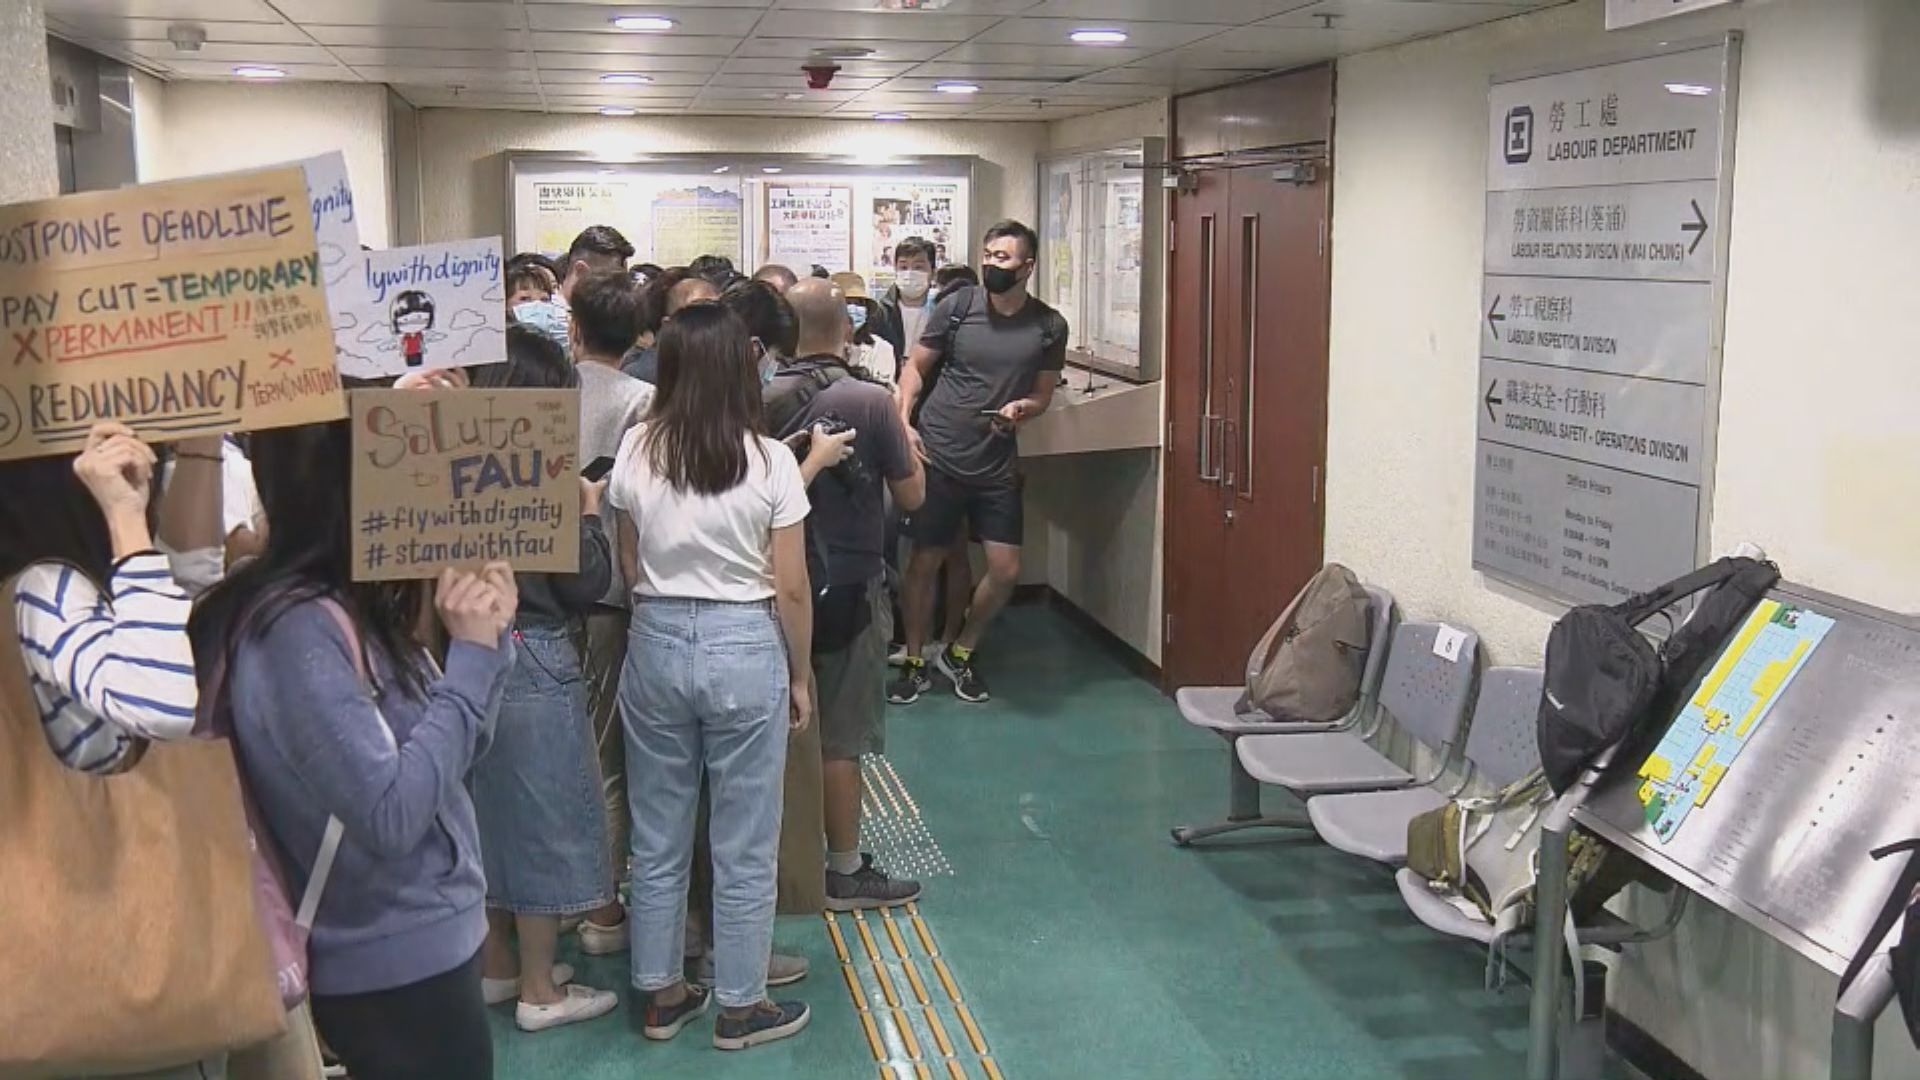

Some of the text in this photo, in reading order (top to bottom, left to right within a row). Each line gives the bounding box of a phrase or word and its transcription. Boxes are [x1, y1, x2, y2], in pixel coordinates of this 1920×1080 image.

[1549, 93, 1618, 133] 勞工處
[1547, 128, 1697, 161] LABOUR DEPARTMENT
[143, 196, 293, 244] DEADLINE
[308, 179, 353, 231] gnity
[1511, 242, 1684, 263] LABOUR RELATIONS DIVISION (KWAI CHUNG)
[2, 289, 58, 328] PAY
[1507, 329, 1617, 354] LABOUR INSPECTION DIVISION
[30, 360, 246, 427] REDUNDANCY
[1505, 413, 1557, 438] OCCUPATIONAL
[1559, 423, 1587, 443] SAFETY
[1595, 430, 1646, 456] OPERATIONS
[1649, 439, 1689, 463] DIVISION
[450, 450, 542, 499] FAU
[361, 497, 563, 535] #flywithdignity
[365, 529, 554, 569] #standwithfau
